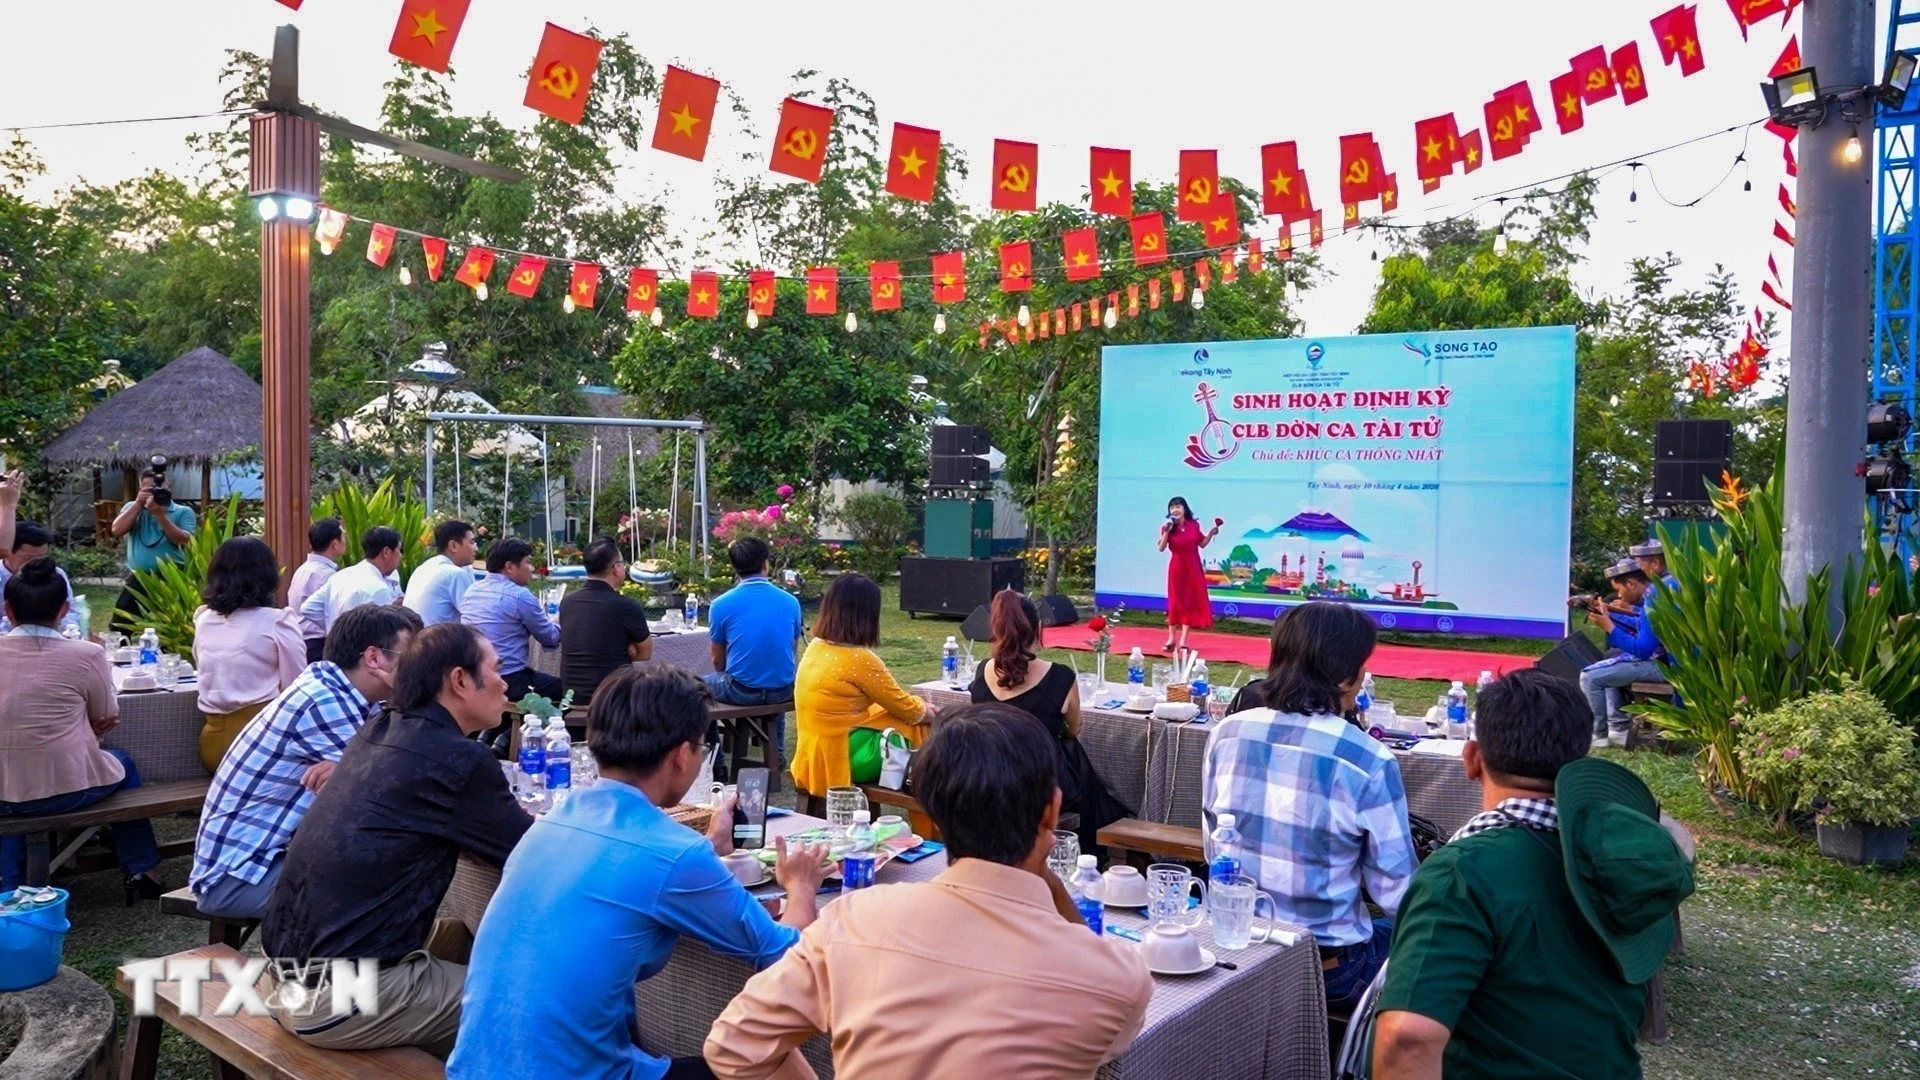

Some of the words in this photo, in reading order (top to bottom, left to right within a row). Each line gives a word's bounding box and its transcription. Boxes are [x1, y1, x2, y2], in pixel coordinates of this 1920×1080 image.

[1434, 342, 1469, 353] SONG
[1472, 341, 1498, 354] TẠO
[1232, 394, 1282, 409] SINH
[1287, 391, 1347, 412] HOẠT
[1353, 390, 1410, 411] ĐỊNH
[1416, 385, 1450, 406] KỲ
[1232, 423, 1270, 438] CLB
[1275, 418, 1320, 438] ĐỜN
[1326, 422, 1356, 438] CA
[1362, 417, 1401, 437] TÀI
[1408, 415, 1442, 437] TỬ
[1251, 448, 1274, 461] Chủ
[1296, 446, 1333, 461] KHÚC
[1335, 449, 1352, 461] CA
[1356, 445, 1401, 461] THỐNG
[1405, 444, 1444, 461] NHẤT
[1363, 481, 1373, 489] 10
